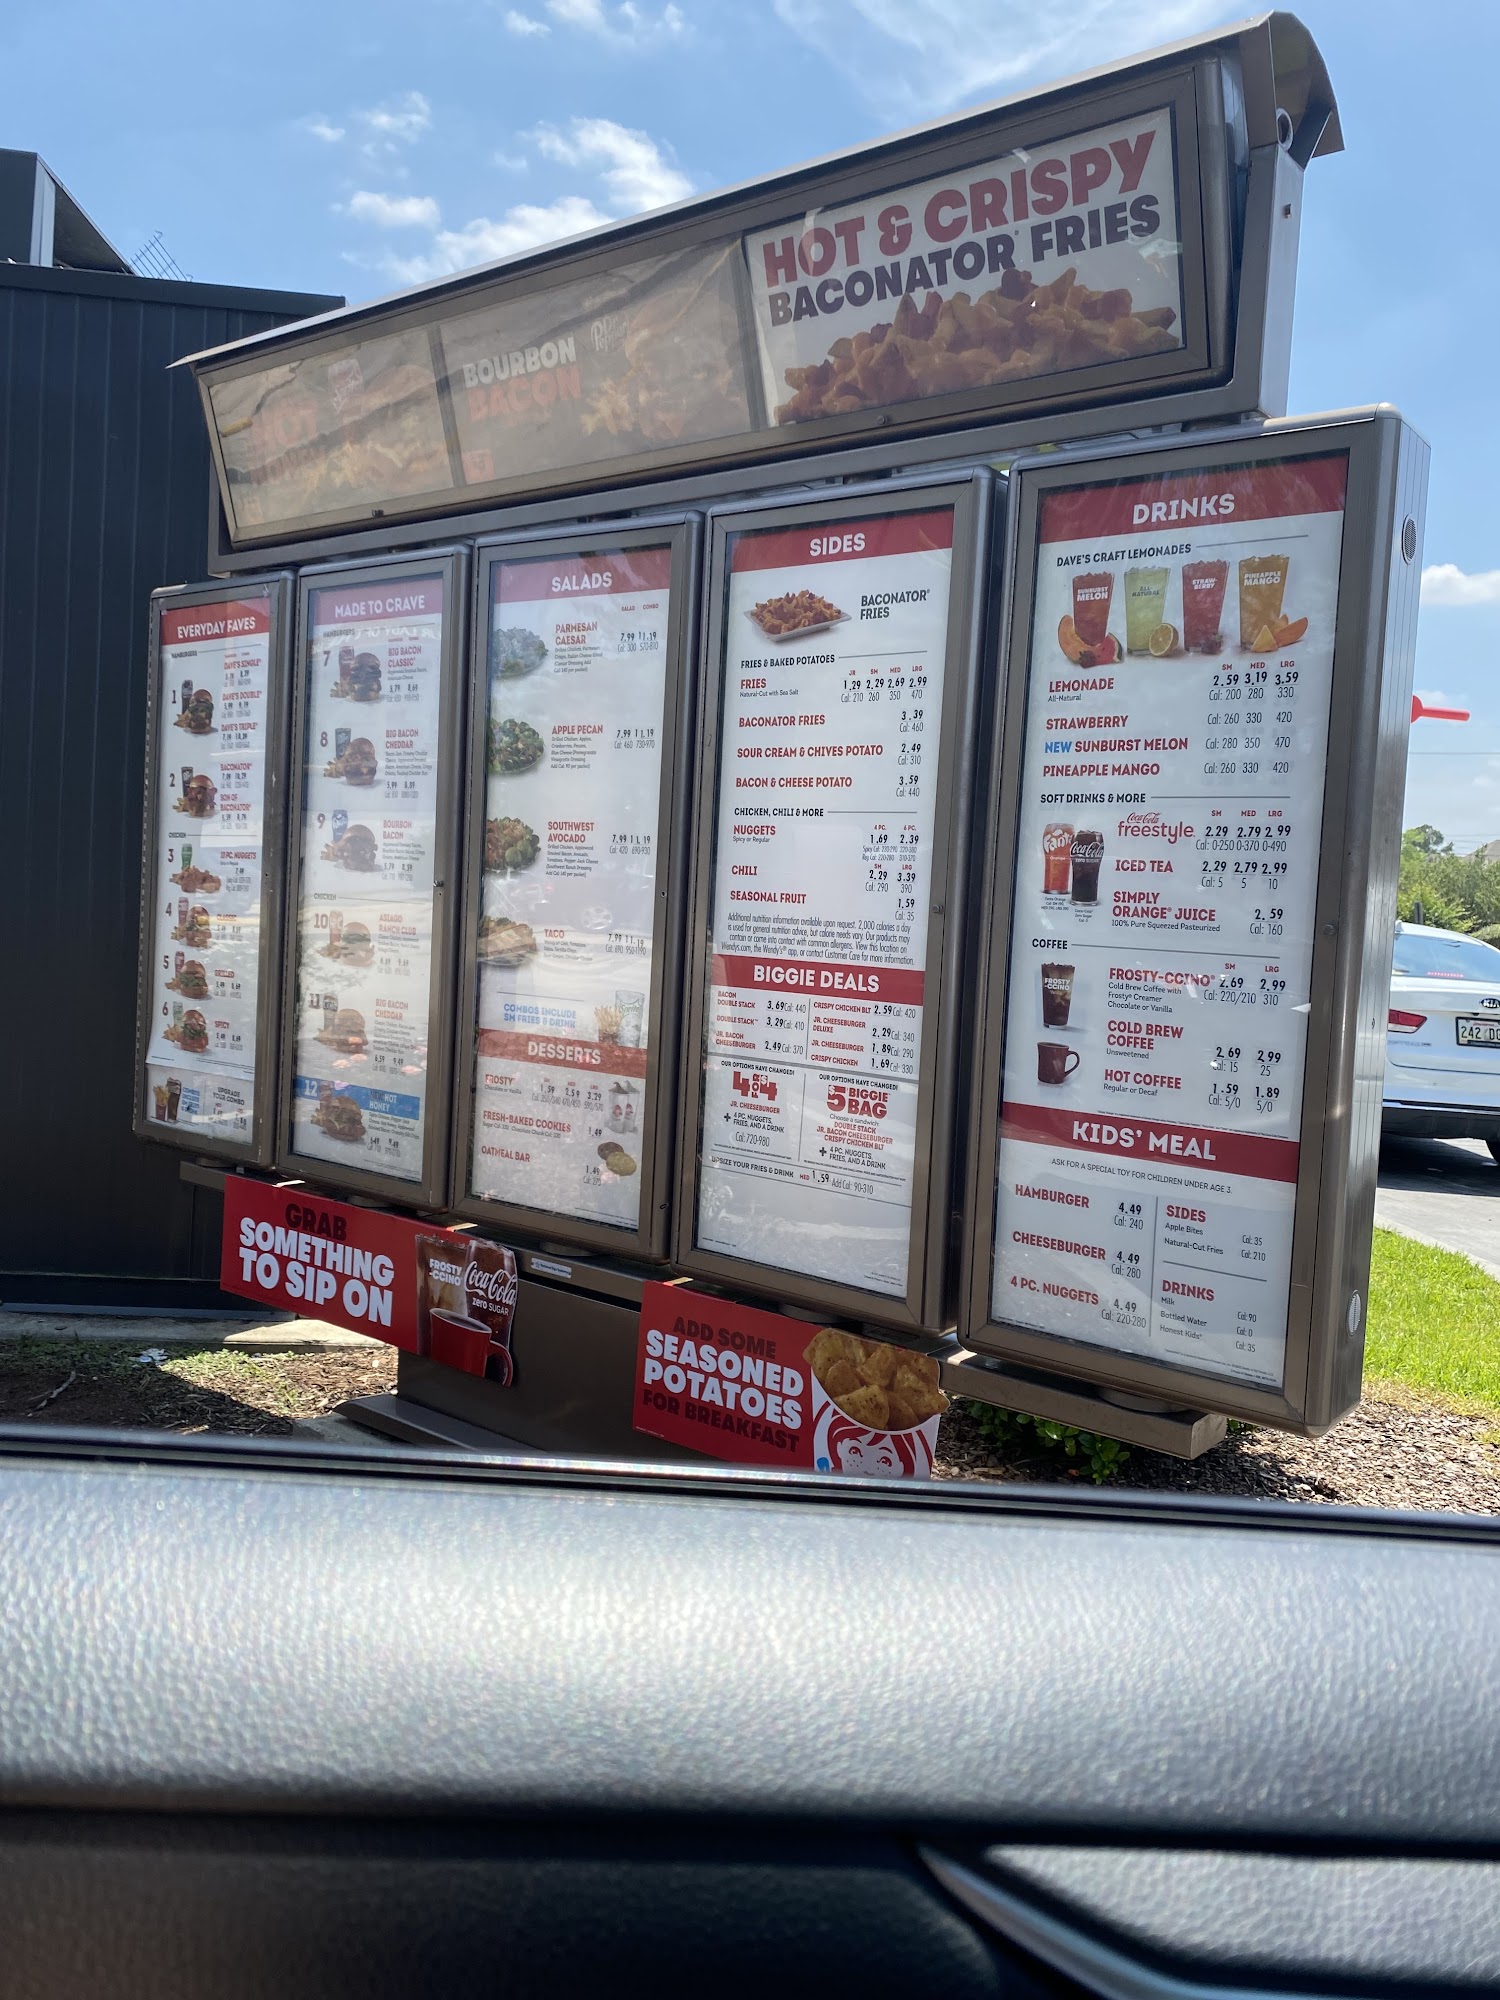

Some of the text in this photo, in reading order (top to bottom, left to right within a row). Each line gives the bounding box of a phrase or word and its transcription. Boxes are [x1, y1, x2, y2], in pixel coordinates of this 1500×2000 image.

[763, 130, 1156, 288] HOT & CRISPY
[1031, 194, 1161, 263] FRIES
[462, 333, 577, 388] BOURBON
[467, 365, 581, 421] BACON
[1132, 494, 1235, 525] DRINKS
[810, 533, 865, 556] SIDES
[1056, 544, 1192, 567] DAVE'S CRAFT LEMONADES
[551, 572, 612, 592] SALADS
[335, 595, 425, 617] MADE TO CRAVE
[860, 607, 889, 620] FRIES
[177, 616, 256, 639] EVERYDAY FAVES
[555, 622, 598, 634] PARMESAN
[556, 635, 586, 645] CAESAR
[741, 655, 835, 668] FRIES & BAKED POTATOES
[741, 679, 766, 689] FRIES
[843, 677, 927, 691] 1.29 2.29 2.69 2.99
[1049, 678, 1114, 692] LEMONADE
[1214, 671, 1298, 687] 2.59 3.19 3.59
[1209, 686, 1294, 700] Cal: 200 280 330
[739, 715, 825, 728] BACONATOR FRIES
[901, 710, 923, 721] 3.39
[1046, 715, 1128, 730] STRAWBERRY
[552, 725, 603, 734] APPLE PECAN
[320, 731, 328, 747] 8
[1045, 738, 1188, 753] NEW SUNBURST MELON
[737, 745, 883, 758] SOUR CREAM & CHIVES POTATO
[901, 744, 921, 754] 2.49
[1043, 764, 1160, 777] PINEAPPLE MANGO
[736, 777, 852, 787] BACON & CHEESE POTATO
[899, 776, 919, 786] 3.59
[1040, 794, 1146, 804] SOFT DRINKS & MORE
[735, 808, 771, 817] CHICKEN,
[773, 808, 794, 816] CHILI
[796, 808, 801, 816] &
[548, 821, 594, 831] SOUTHWEST
[734, 825, 776, 835] NUGGETS
[1118, 821, 1195, 844] freestyle
[548, 834, 586, 843] AVOCADO
[732, 866, 757, 876] CHILI
[1115, 860, 1173, 872] ICED TEA
[1202, 862, 1287, 874] 2.29 2.79 2.99
[730, 891, 806, 904] SEASONAL FRUIT
[1113, 891, 1160, 904] SIMPLY
[314, 913, 328, 929] 10
[1175, 908, 1216, 922] JUICE
[1254, 909, 1283, 920] 2.59
[544, 929, 565, 938] TACO
[1148, 922, 1179, 931] Squeezed
[1180, 924, 1220, 932] Pasteurized
[1032, 939, 1068, 949] COFFEE
[754, 965, 880, 992] BIGGIE DEALS
[504, 1004, 577, 1019] COMBOS INCLUDE
[1108, 1020, 1184, 1039] COLD BREW
[1461, 1026, 1481, 1039] 242
[1107, 1034, 1154, 1050] COFFEE
[528, 1042, 601, 1065] DESSERTS
[1104, 1069, 1181, 1090] HOT COFFEE
[304, 1080, 318, 1097] 12
[849, 1088, 889, 1102] BIGGIE
[848, 1100, 887, 1119] BAG
[483, 1111, 571, 1133] FRESH-BAKED COOKIES
[1072, 1120, 1143, 1148] KIDS'
[1149, 1133, 1216, 1161] MEAL
[481, 1146, 530, 1162] OATMEAL BAR
[1051, 1158, 1065, 1166] ASK
[1066, 1160, 1079, 1168] FOR
[1087, 1163, 1115, 1174] SPECIAL
[1117, 1168, 1130, 1176] TOY
[1132, 1170, 1146, 1178] FOR
[1147, 1173, 1182, 1185] CHILDREN
[1184, 1178, 1208, 1189] UNDER
[1210, 1183, 1224, 1192] AGE
[1226, 1185, 1233, 1193] 3.
[1015, 1184, 1090, 1208] HAMBURGER
[285, 1203, 347, 1241] GRAB
[1166, 1205, 1206, 1223] SIDES
[240, 1217, 395, 1287] SOMETHING
[1012, 1231, 1106, 1260] CHEESEBURGER
[429, 1259, 462, 1274] FROSTY
[239, 1247, 393, 1328] TO SIP ON
[1010, 1276, 1099, 1305] 4 PC. NUGGETS
[1162, 1280, 1215, 1301] DRINKS
[472, 1298, 509, 1316] zero SUGAR
[673, 1317, 776, 1360] ADD SOME
[646, 1329, 804, 1397] SEASONED
[644, 1358, 802, 1430] POTATOES
[643, 1389, 799, 1452] FOR BREAKFAST
